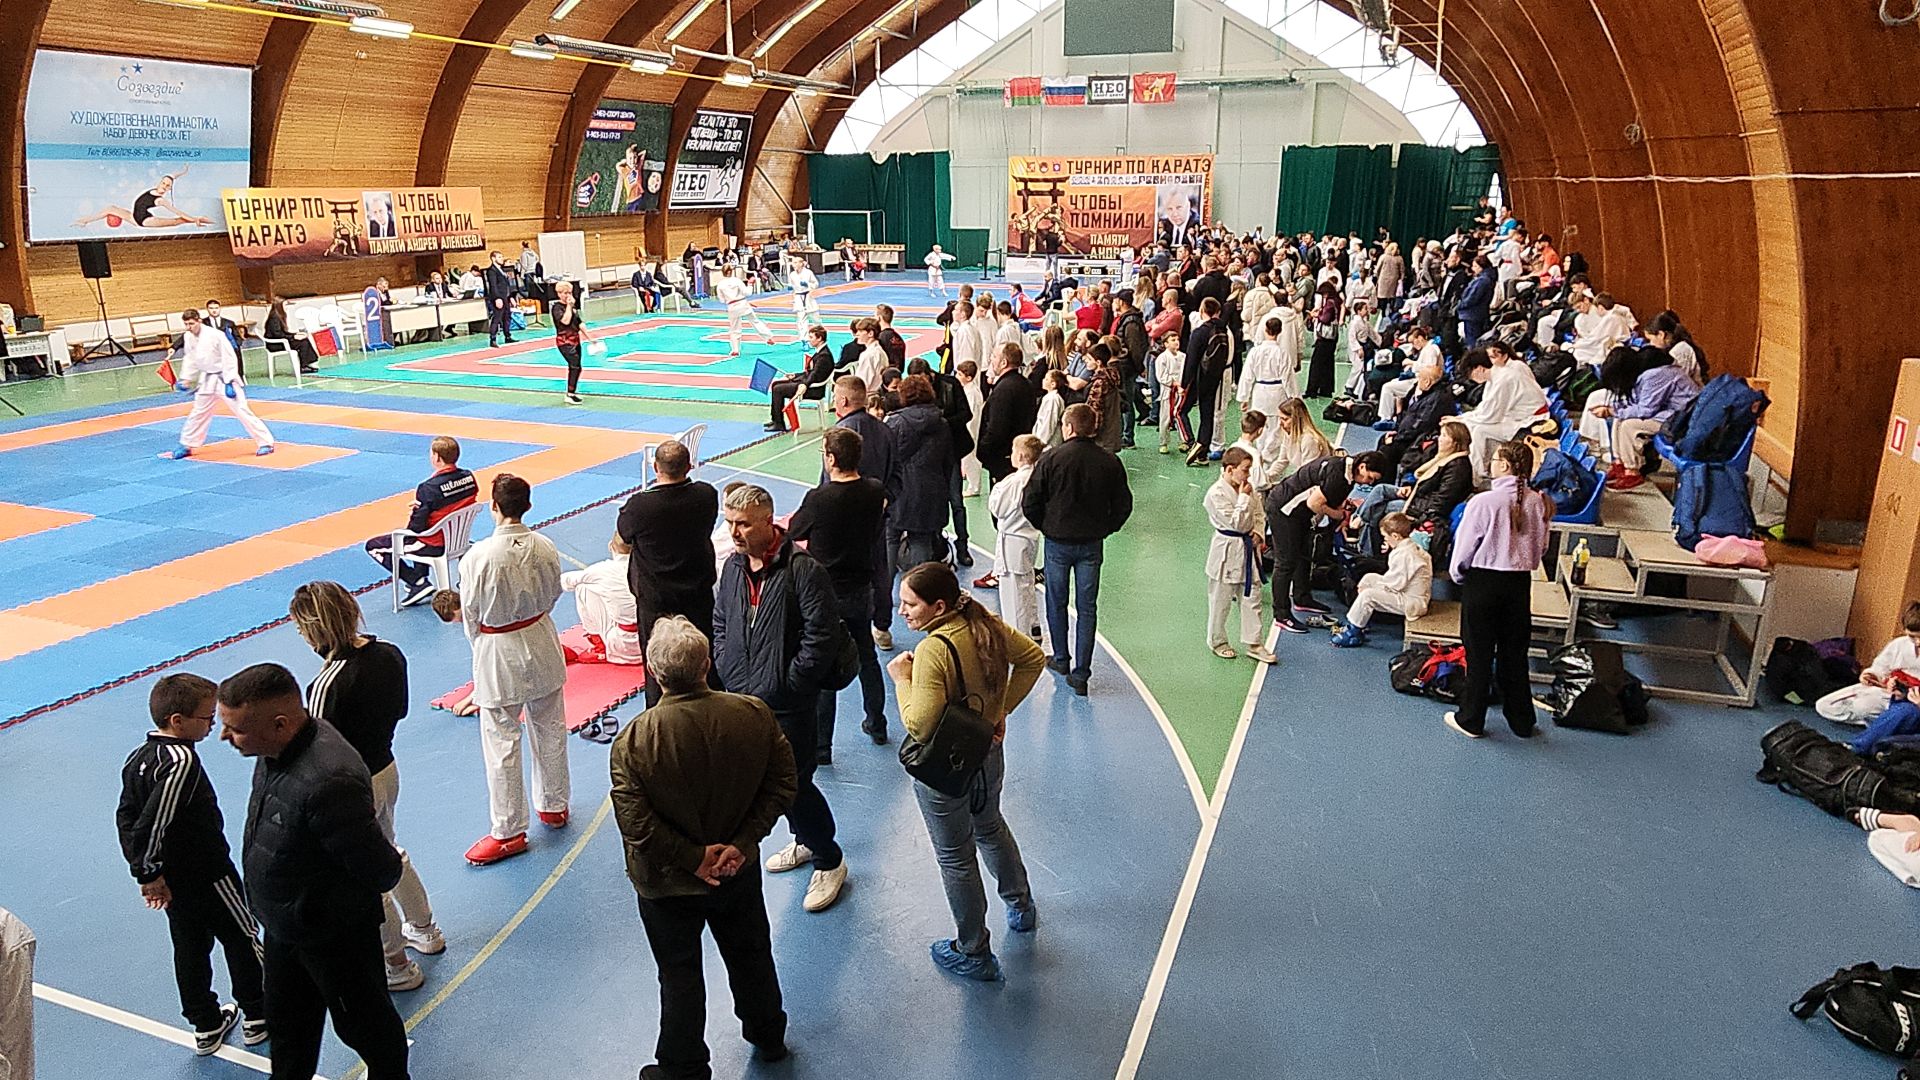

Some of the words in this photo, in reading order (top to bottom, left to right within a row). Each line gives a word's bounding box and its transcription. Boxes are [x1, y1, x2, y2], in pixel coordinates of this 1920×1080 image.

[117, 75, 182, 98] Созвездие
[1094, 83, 1124, 93] НЕО
[70, 111, 161, 127] ХУДОЖЕСТВЕННАЯ
[162, 115, 218, 130] ГИМНАСТИКА
[103, 127, 127, 138] НАБОР
[129, 129, 160, 140] ДЕВОЧЕК
[179, 131, 191, 140] ЛЕТ
[1067, 160, 1122, 174] ТУРНИР
[1126, 160, 1145, 174] ПО
[1152, 159, 1211, 174] КАРАТЭ
[676, 174, 707, 191] НЕО
[227, 198, 297, 221] ТУРНИР
[301, 198, 325, 219] ПО
[398, 193, 450, 212] ЧТОБЫ
[1070, 194, 1121, 210] ЧТОБЫ
[232, 224, 307, 248] КАРАТЭ
[369, 239, 404, 254] ПАМЯТИ
[407, 237, 438, 252] АНДРЕЯ
[441, 234, 483, 250] АЛЕКСЕЕВА
[1090, 233, 1129, 245] ПАМЯТИ
[366, 297, 380, 321] 2
